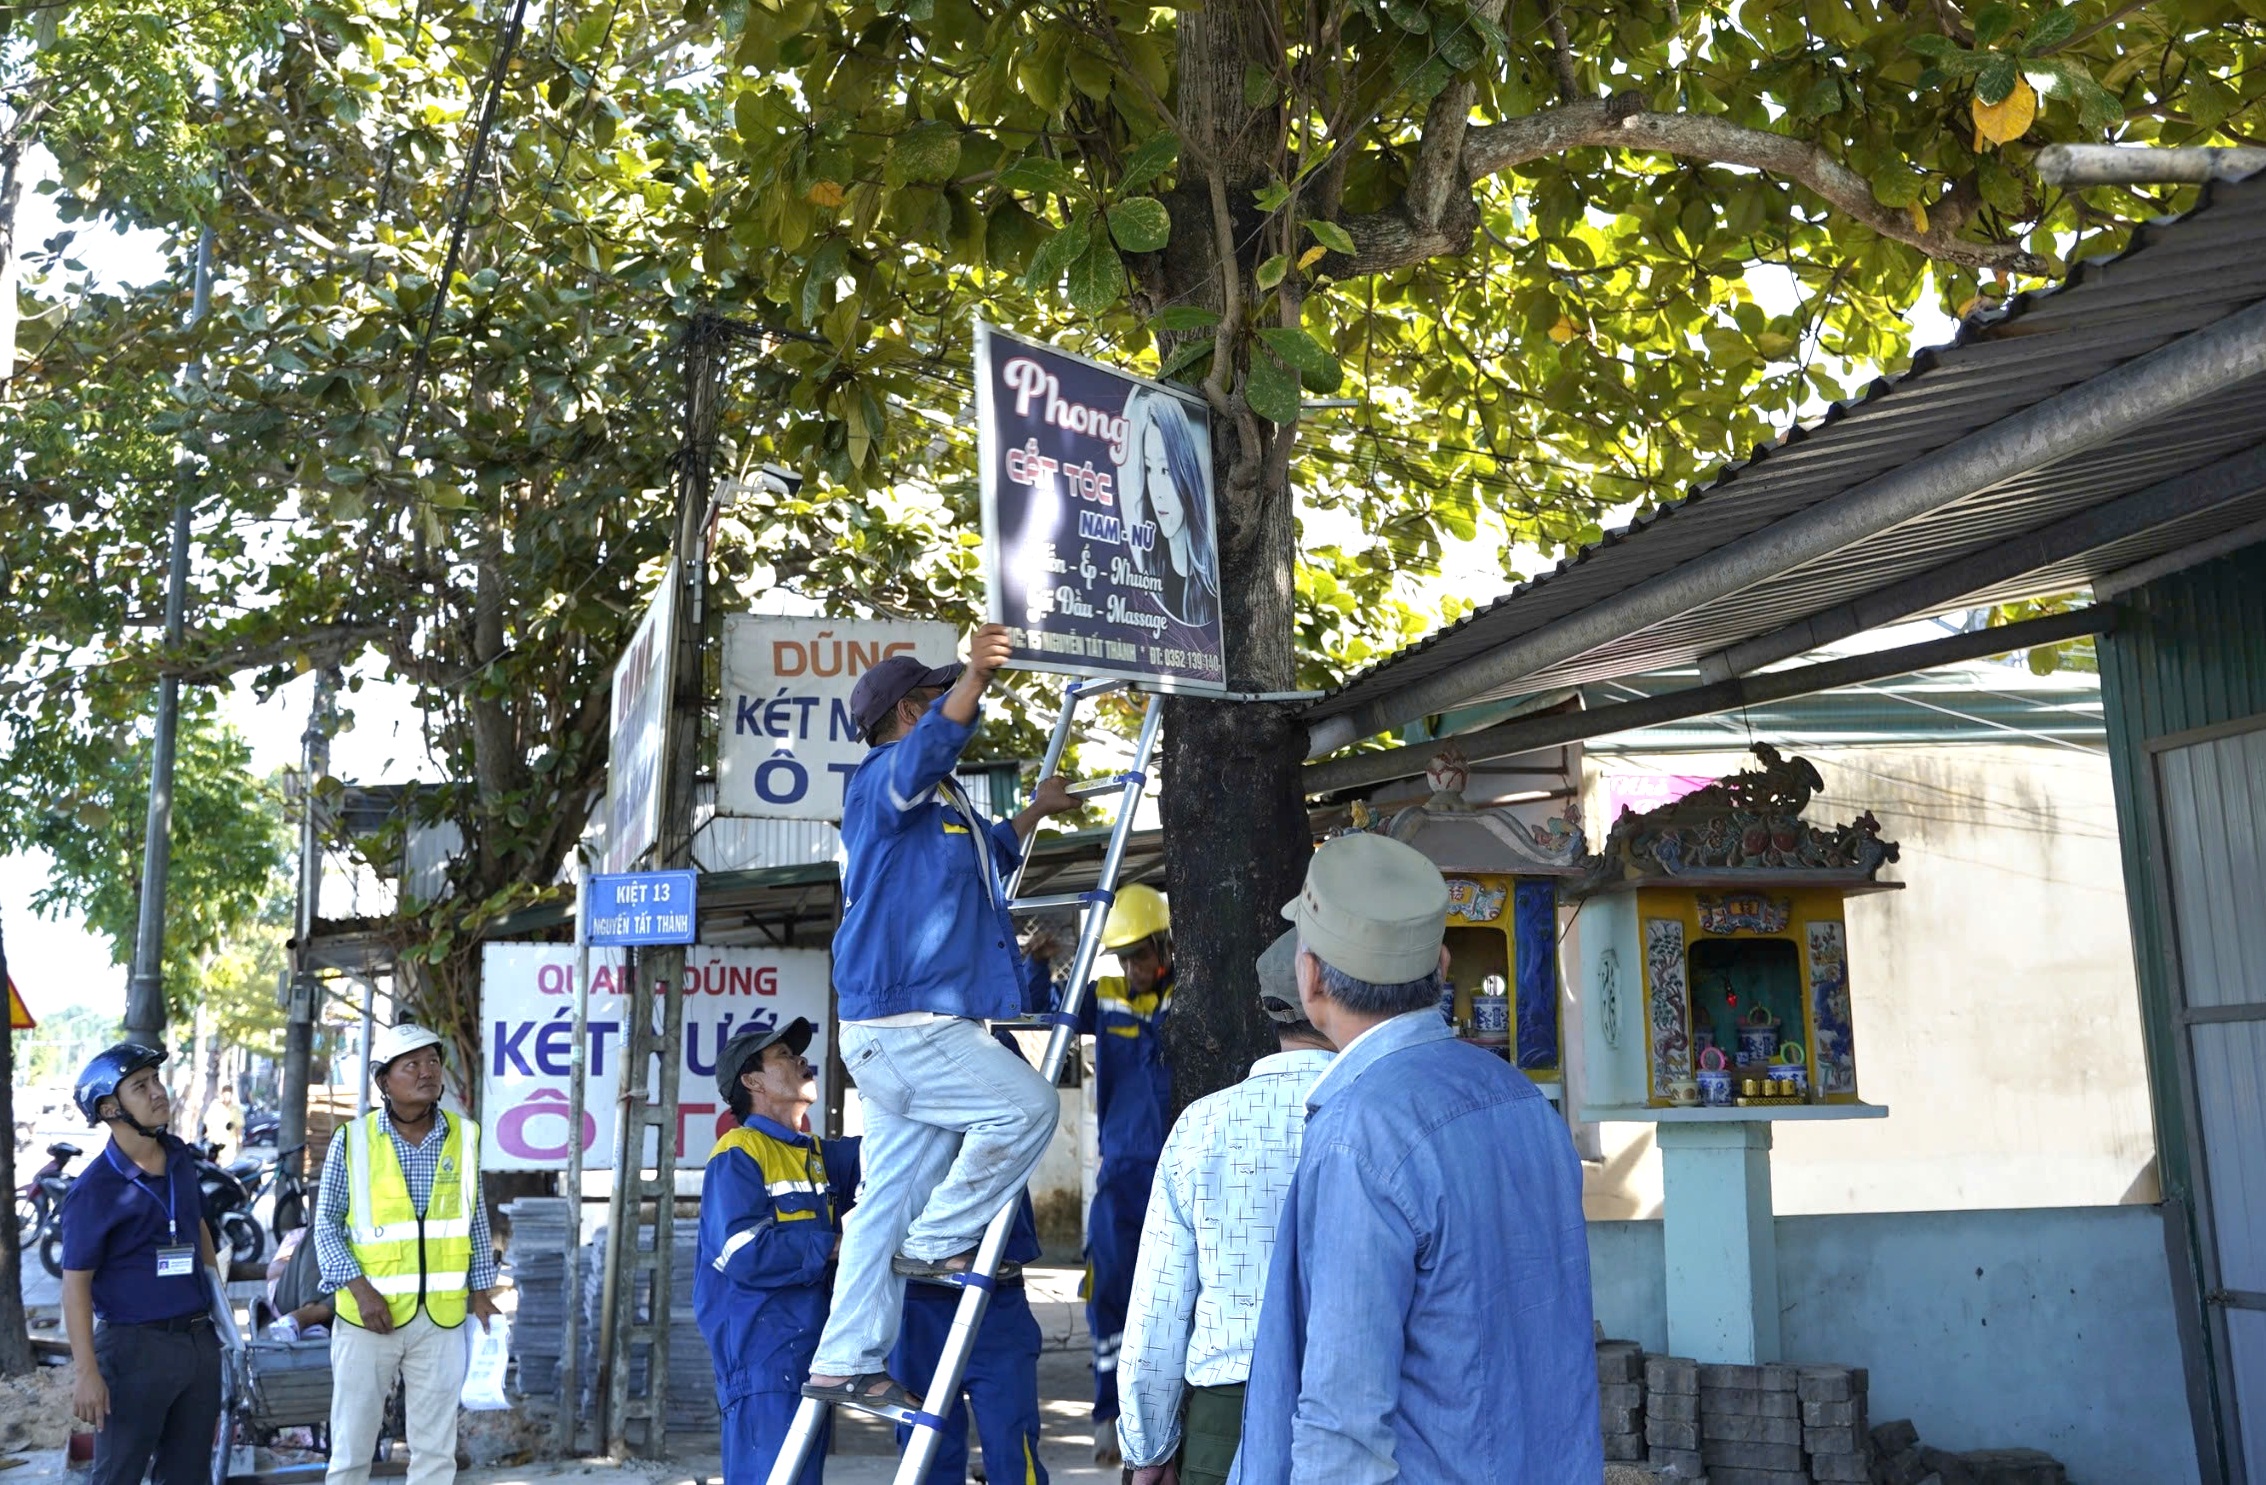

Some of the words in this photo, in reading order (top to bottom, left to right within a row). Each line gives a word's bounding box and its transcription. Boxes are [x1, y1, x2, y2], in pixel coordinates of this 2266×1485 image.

[1003, 356, 1131, 467] Phong
[1063, 461, 1113, 506] TÓC
[1078, 509, 1120, 545] NAM
[1130, 520, 1156, 552] NỮ
[1079, 543, 1098, 590] Ép
[1110, 556, 1163, 595] Nhuộm
[1055, 585, 1094, 618] Đầu
[1106, 594, 1168, 639] Massage
[1164, 648, 1186, 668] 0352
[1187, 652, 1203, 671] 139
[735, 687, 820, 740] KÉT
[754, 748, 809, 804] Ô
[616, 880, 648, 907] KIỆT
[653, 883, 670, 902] 13
[634, 910, 652, 934] TẤT
[656, 910, 688, 933] THÀNH
[682, 959, 777, 996] DŨNG
[493, 1005, 619, 1077] KÉT
[495, 1087, 596, 1160] Ô
